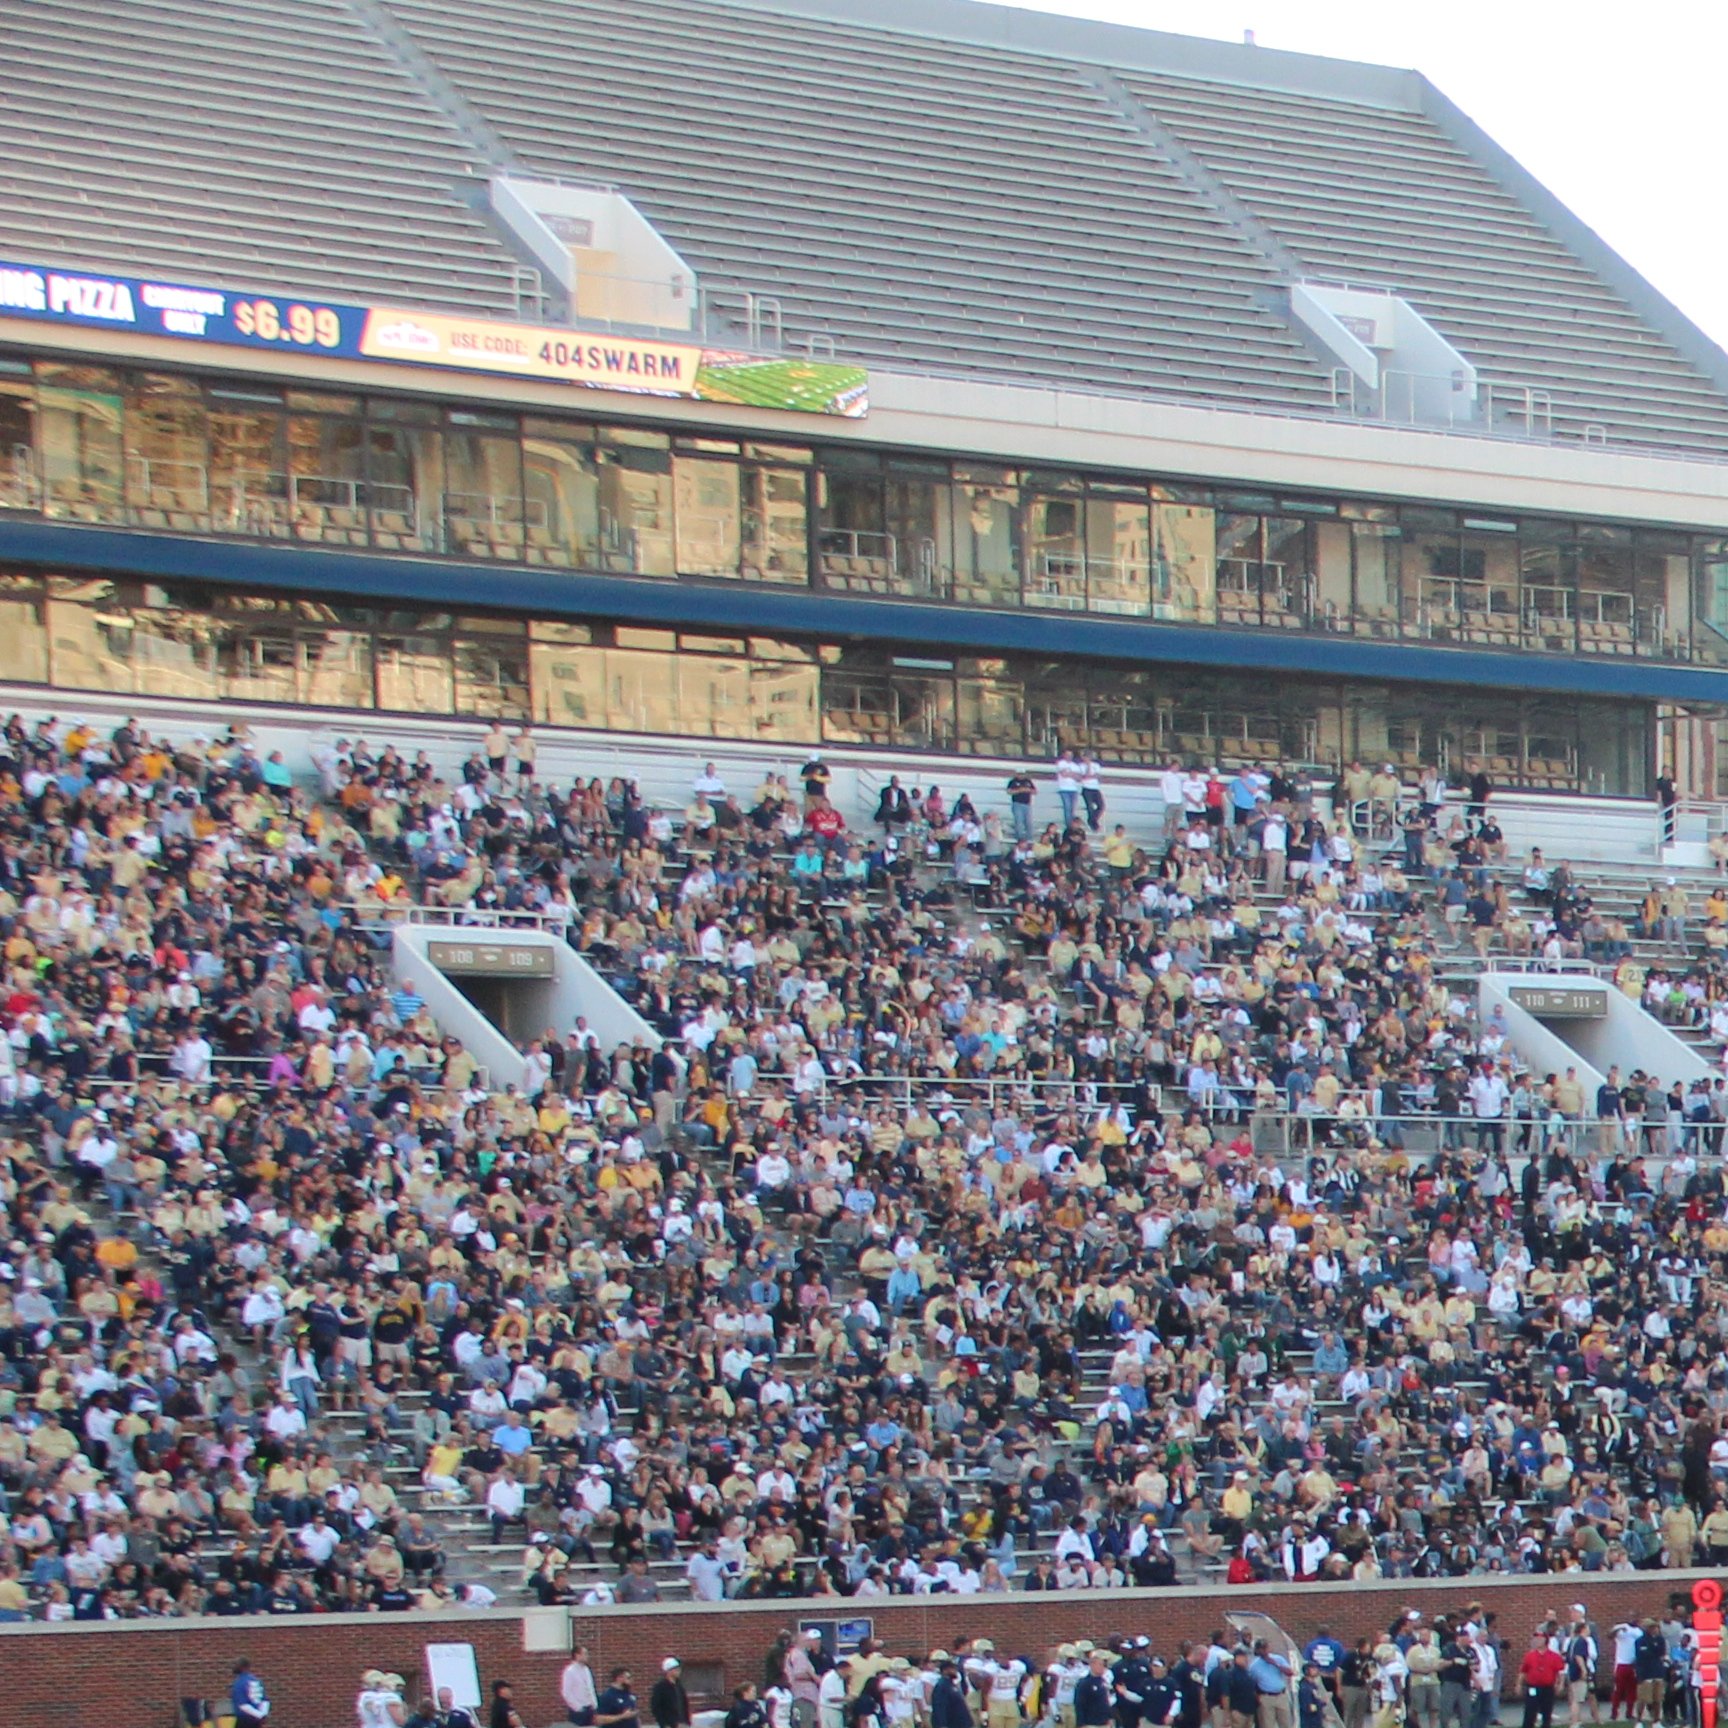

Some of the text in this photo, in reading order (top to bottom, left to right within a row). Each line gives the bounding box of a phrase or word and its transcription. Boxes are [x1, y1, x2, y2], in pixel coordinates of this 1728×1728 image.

[49, 275, 136, 322] PIZZA
[235, 300, 340, 348] $6.99
[539, 340, 681, 379] 404SWARM
